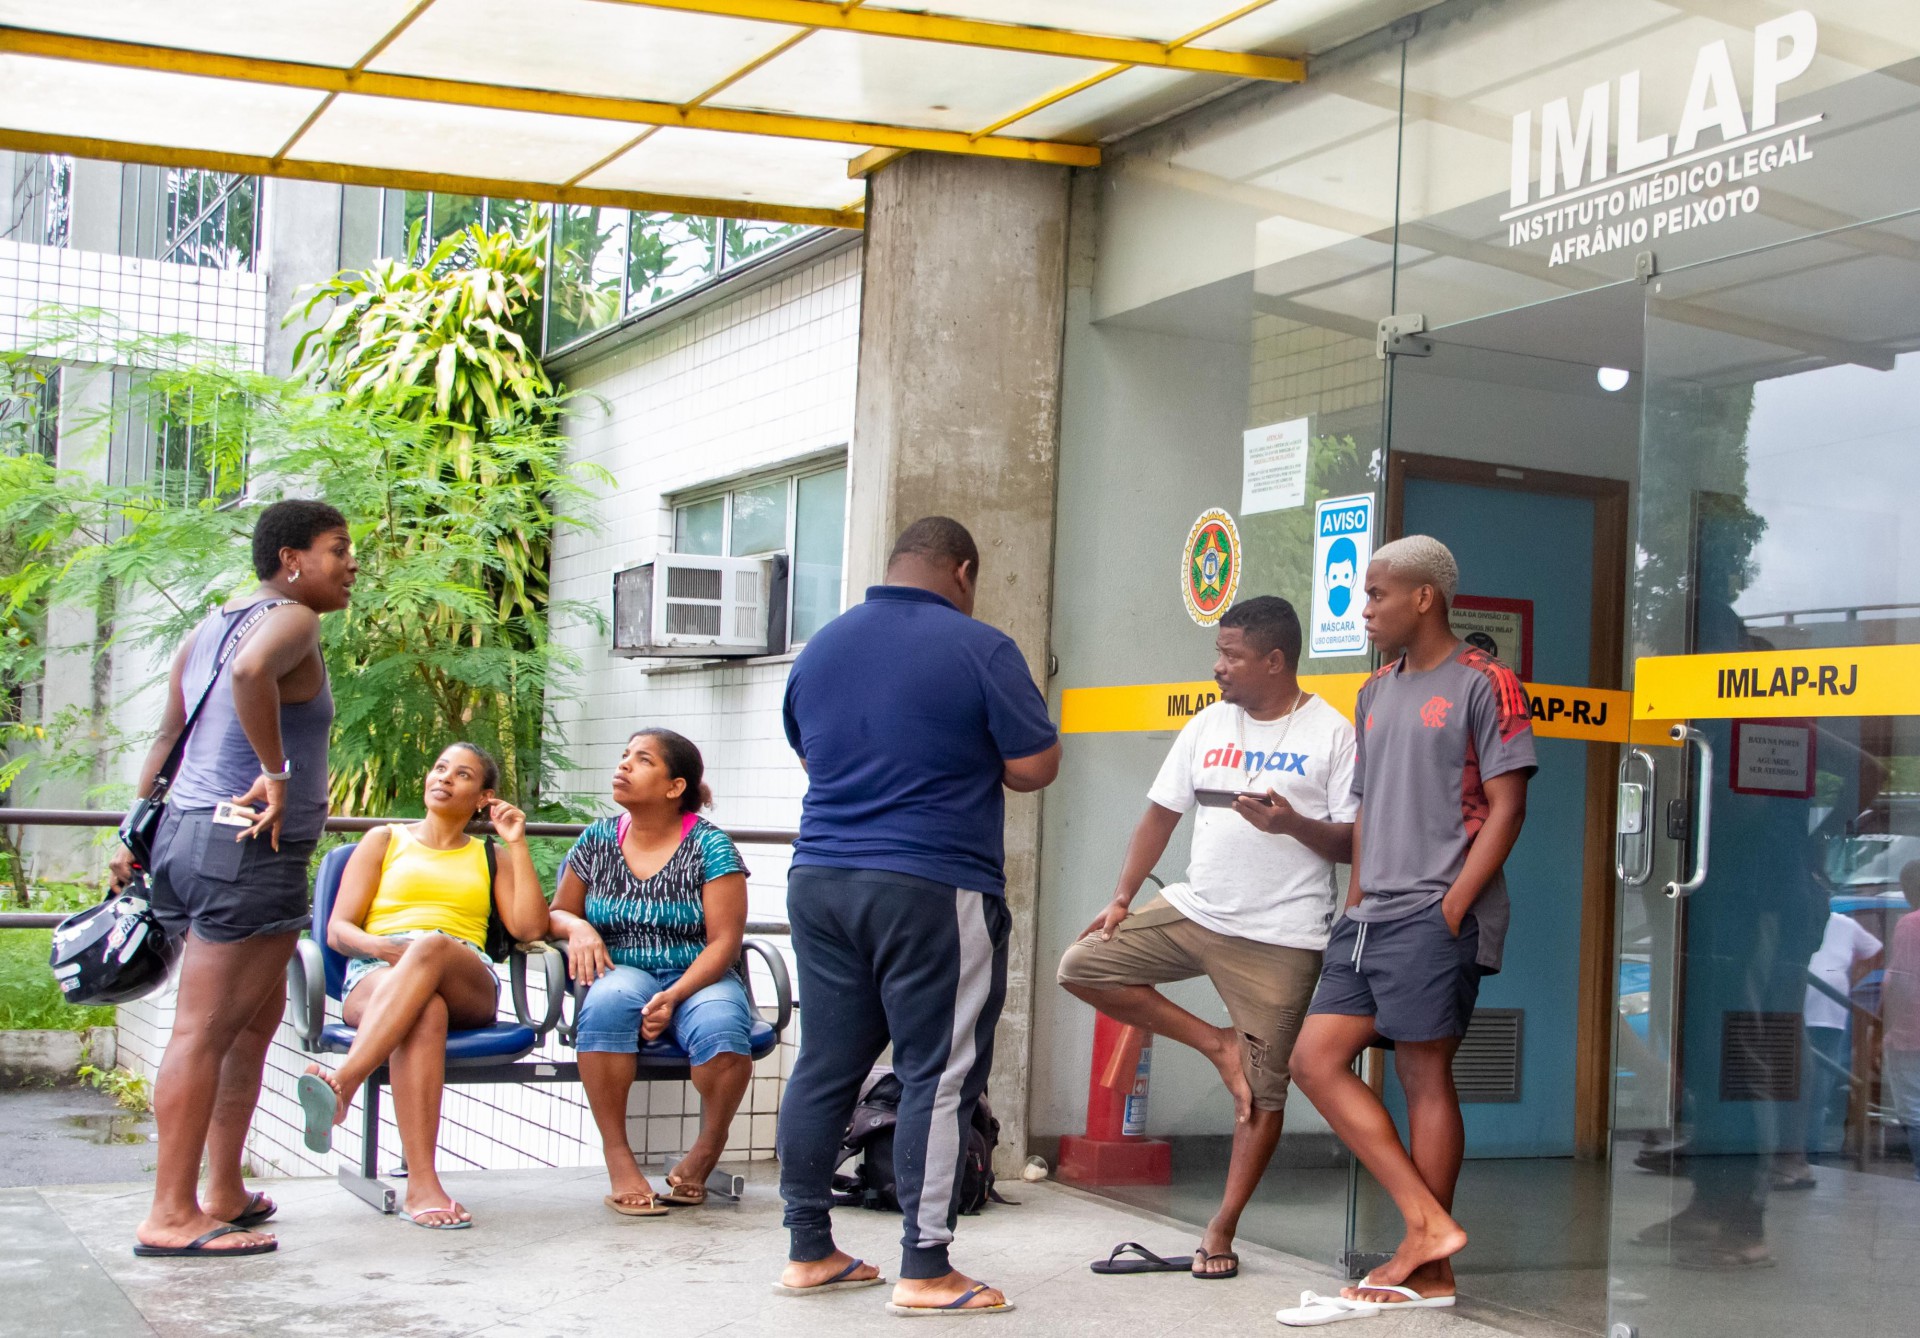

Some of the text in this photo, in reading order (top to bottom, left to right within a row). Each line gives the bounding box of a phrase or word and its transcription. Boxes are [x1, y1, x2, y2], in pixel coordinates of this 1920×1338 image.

[1509, 9, 1818, 209] IMLAP
[1508, 134, 1813, 247] INSTITUTO MÉDICO LEGAL
[1548, 185, 1760, 268] AFRÂNIO PEIXOTO
[1322, 509, 1366, 533] AVISO
[219, 606, 269, 664] FOREVER YOUNG
[1315, 636, 1326, 645] USO
[1320, 620, 1355, 632] MÁSCARA
[1717, 664, 1858, 699] IMLAP-RJ
[1749, 766, 1763, 774] SER
